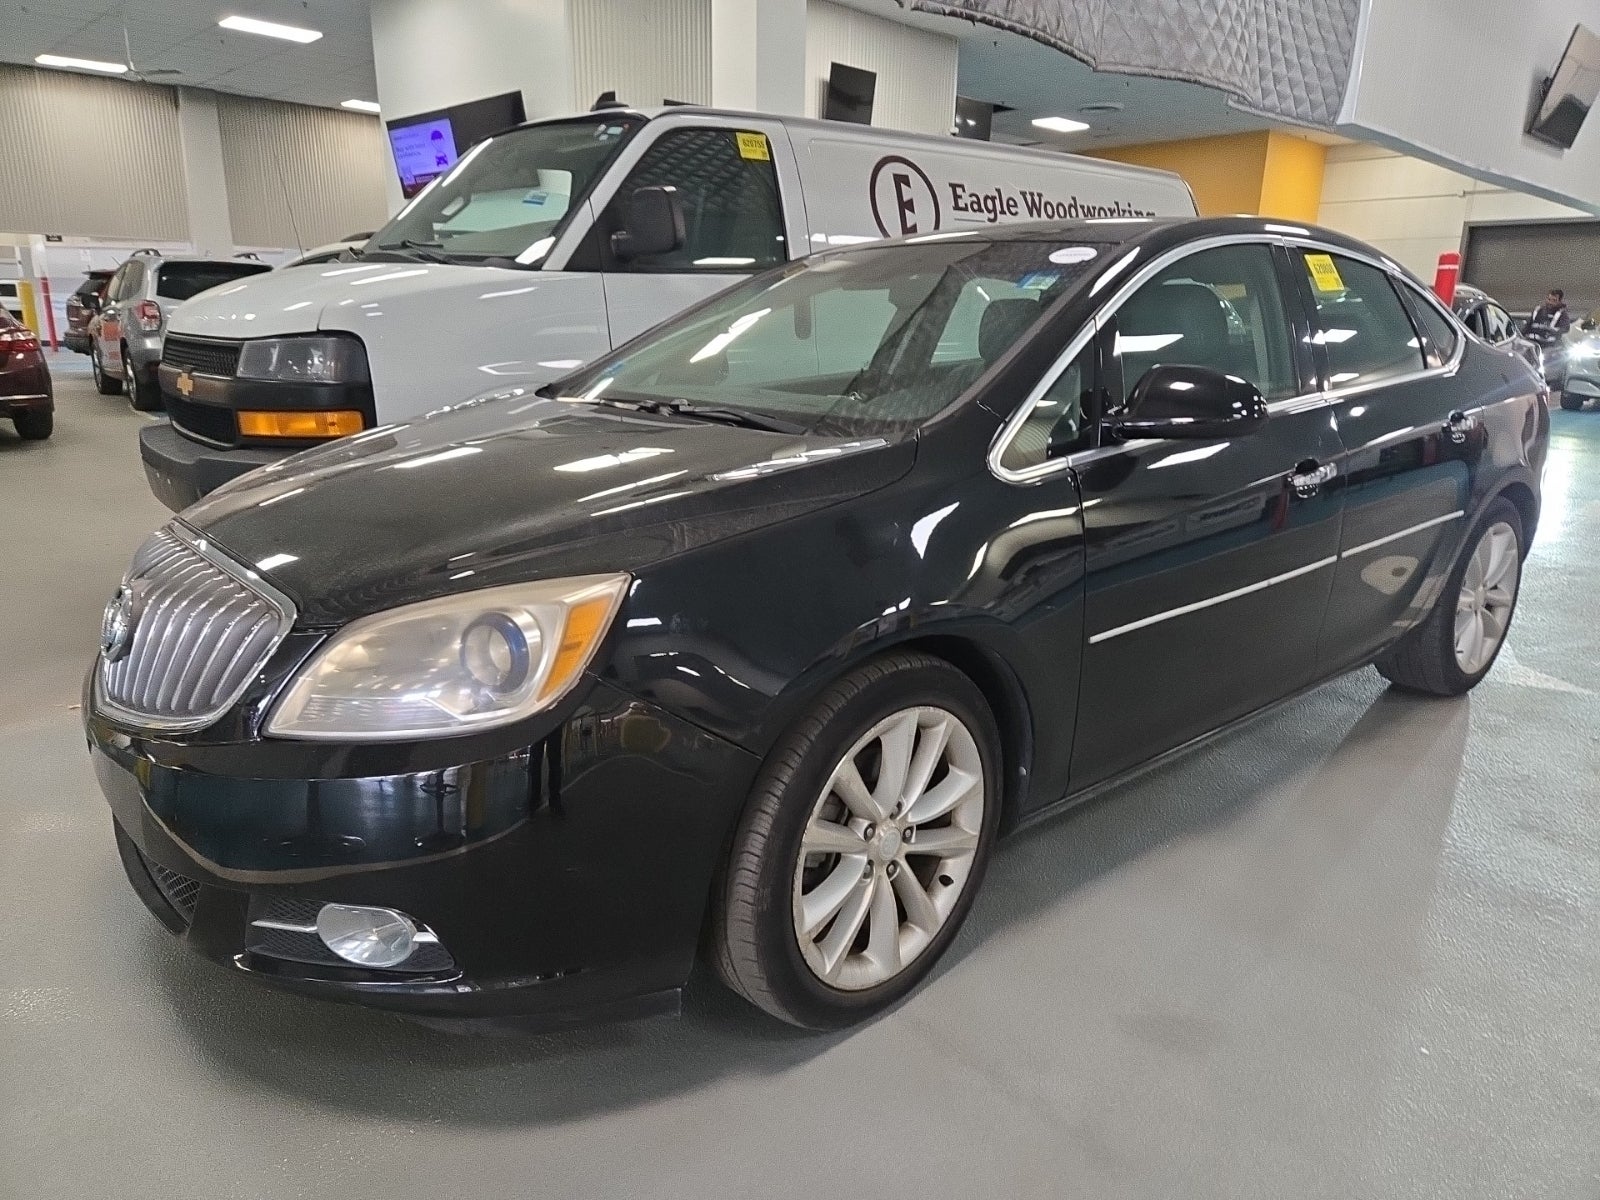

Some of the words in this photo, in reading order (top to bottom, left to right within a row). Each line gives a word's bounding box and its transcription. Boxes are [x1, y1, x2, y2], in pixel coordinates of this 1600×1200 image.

[893, 173, 918, 235] E
[948, 182, 1019, 223] Eagle
[1019, 190, 1156, 219] Woodworki
